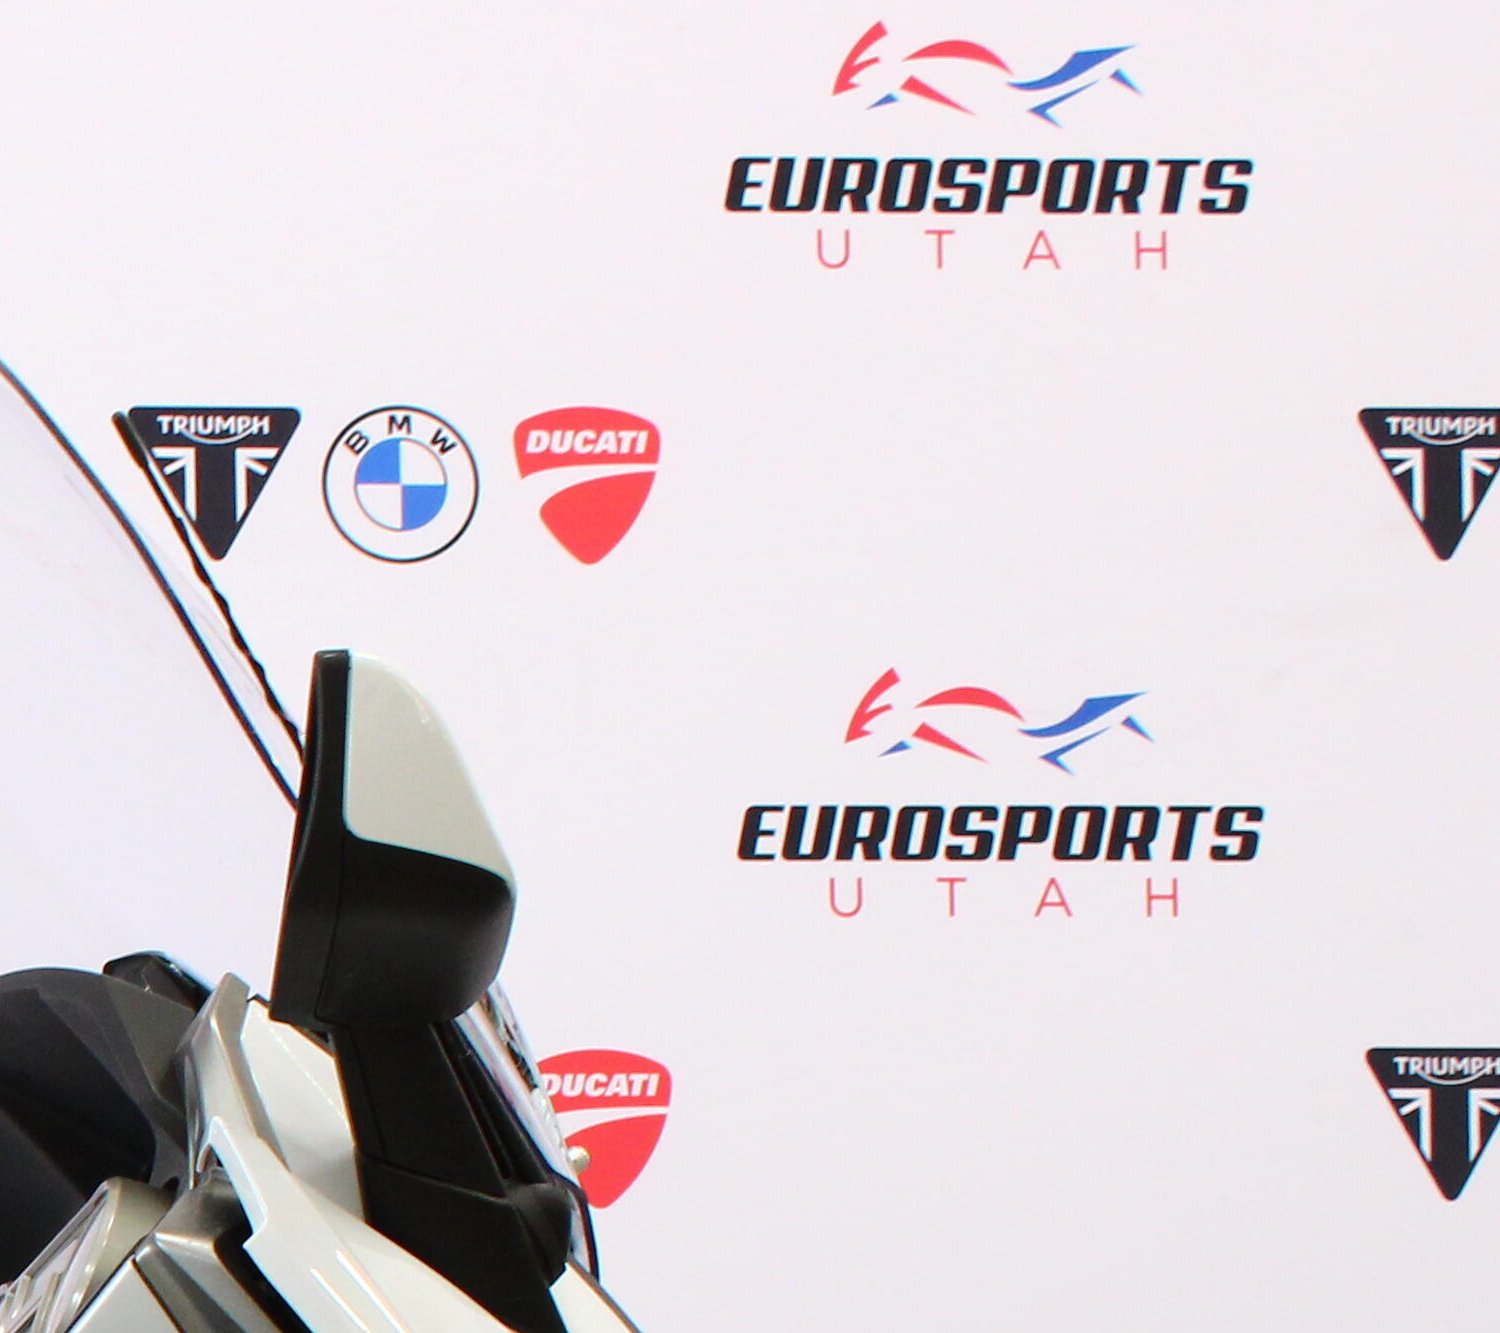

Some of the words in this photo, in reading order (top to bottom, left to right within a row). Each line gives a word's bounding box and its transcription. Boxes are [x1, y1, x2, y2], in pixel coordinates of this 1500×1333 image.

[723, 156, 1254, 215] EUROSPORTS
[815, 228, 1169, 271] UTAH
[156, 414, 271, 436] TRIUMPH
[344, 414, 457, 457] BMW
[526, 429, 648, 454] DUCATI
[1384, 415, 1498, 436] TRIUMPH
[736, 804, 1265, 863] EUROSPORTS
[828, 876, 1180, 919] UTAH
[542, 1072, 660, 1097] DUCATI
